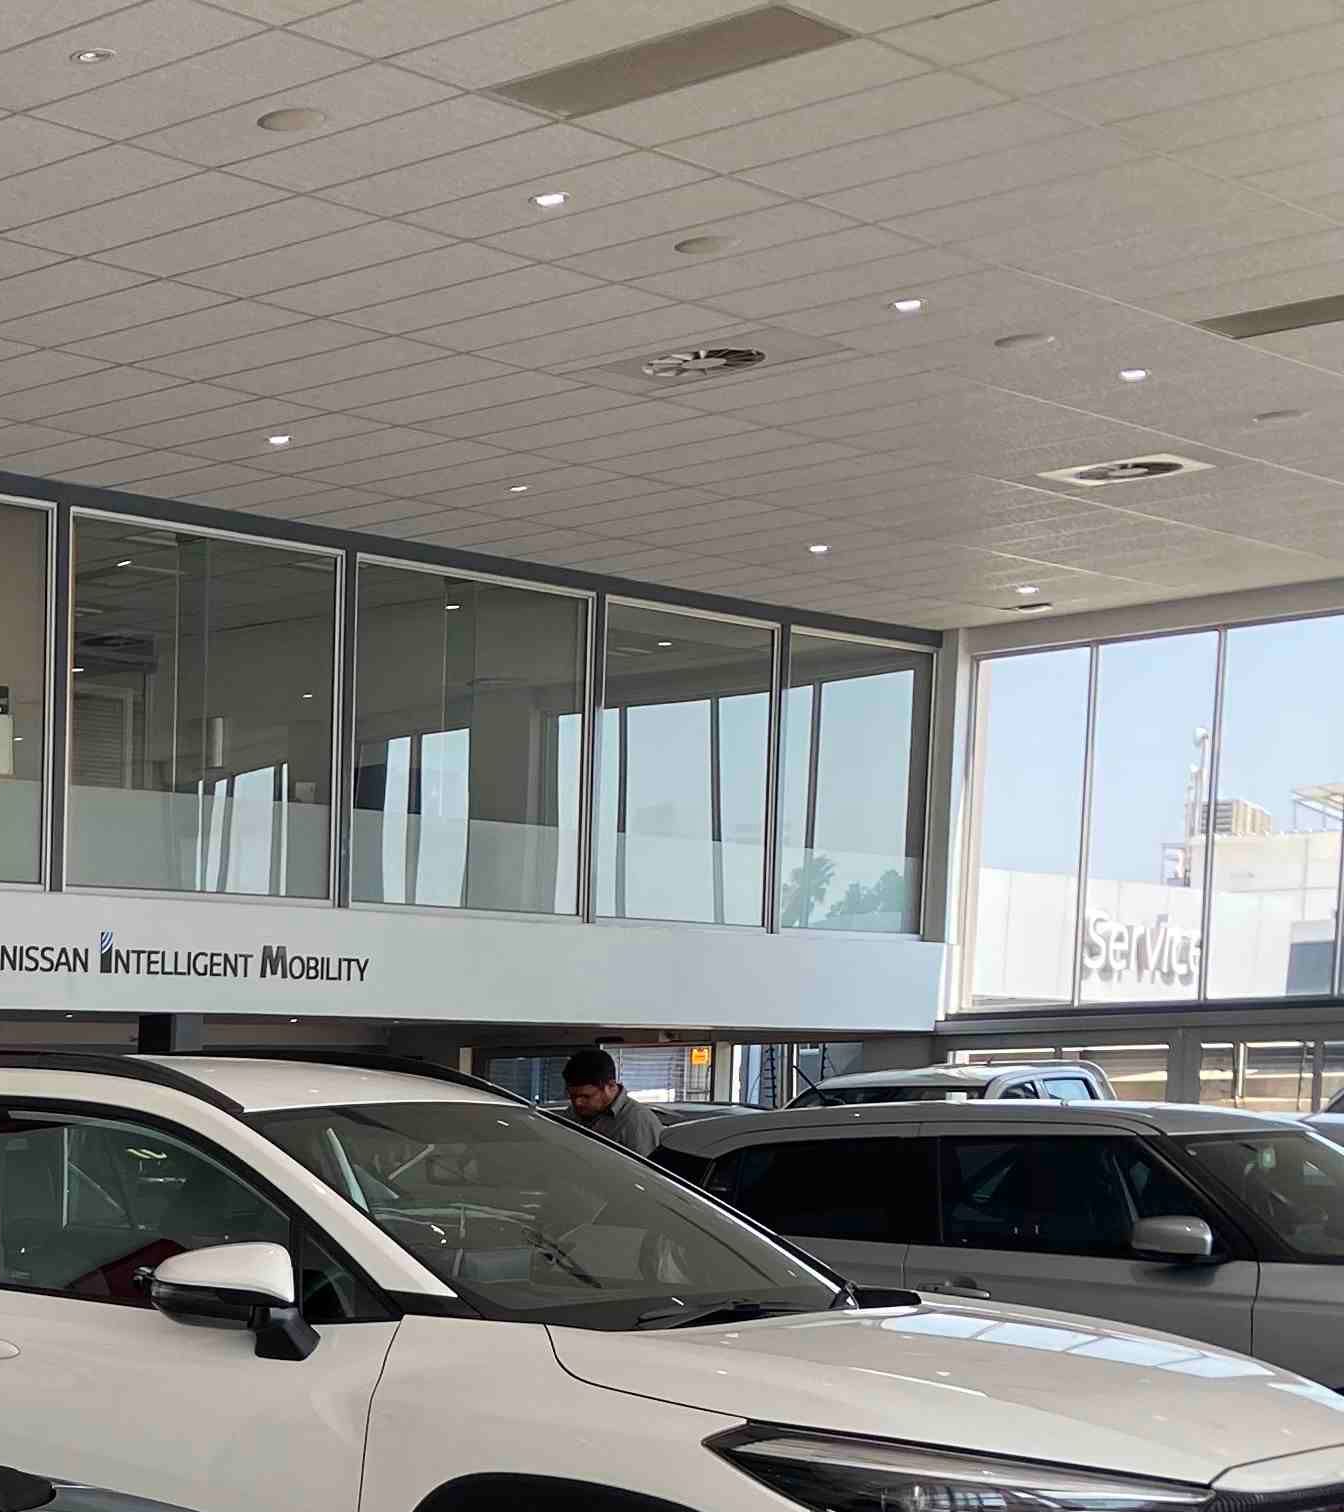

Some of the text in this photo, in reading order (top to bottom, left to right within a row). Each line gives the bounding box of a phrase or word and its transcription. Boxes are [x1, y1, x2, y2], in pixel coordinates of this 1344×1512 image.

[0, 931, 370, 982] NISSAN INTELLIGENT MOBILITY
